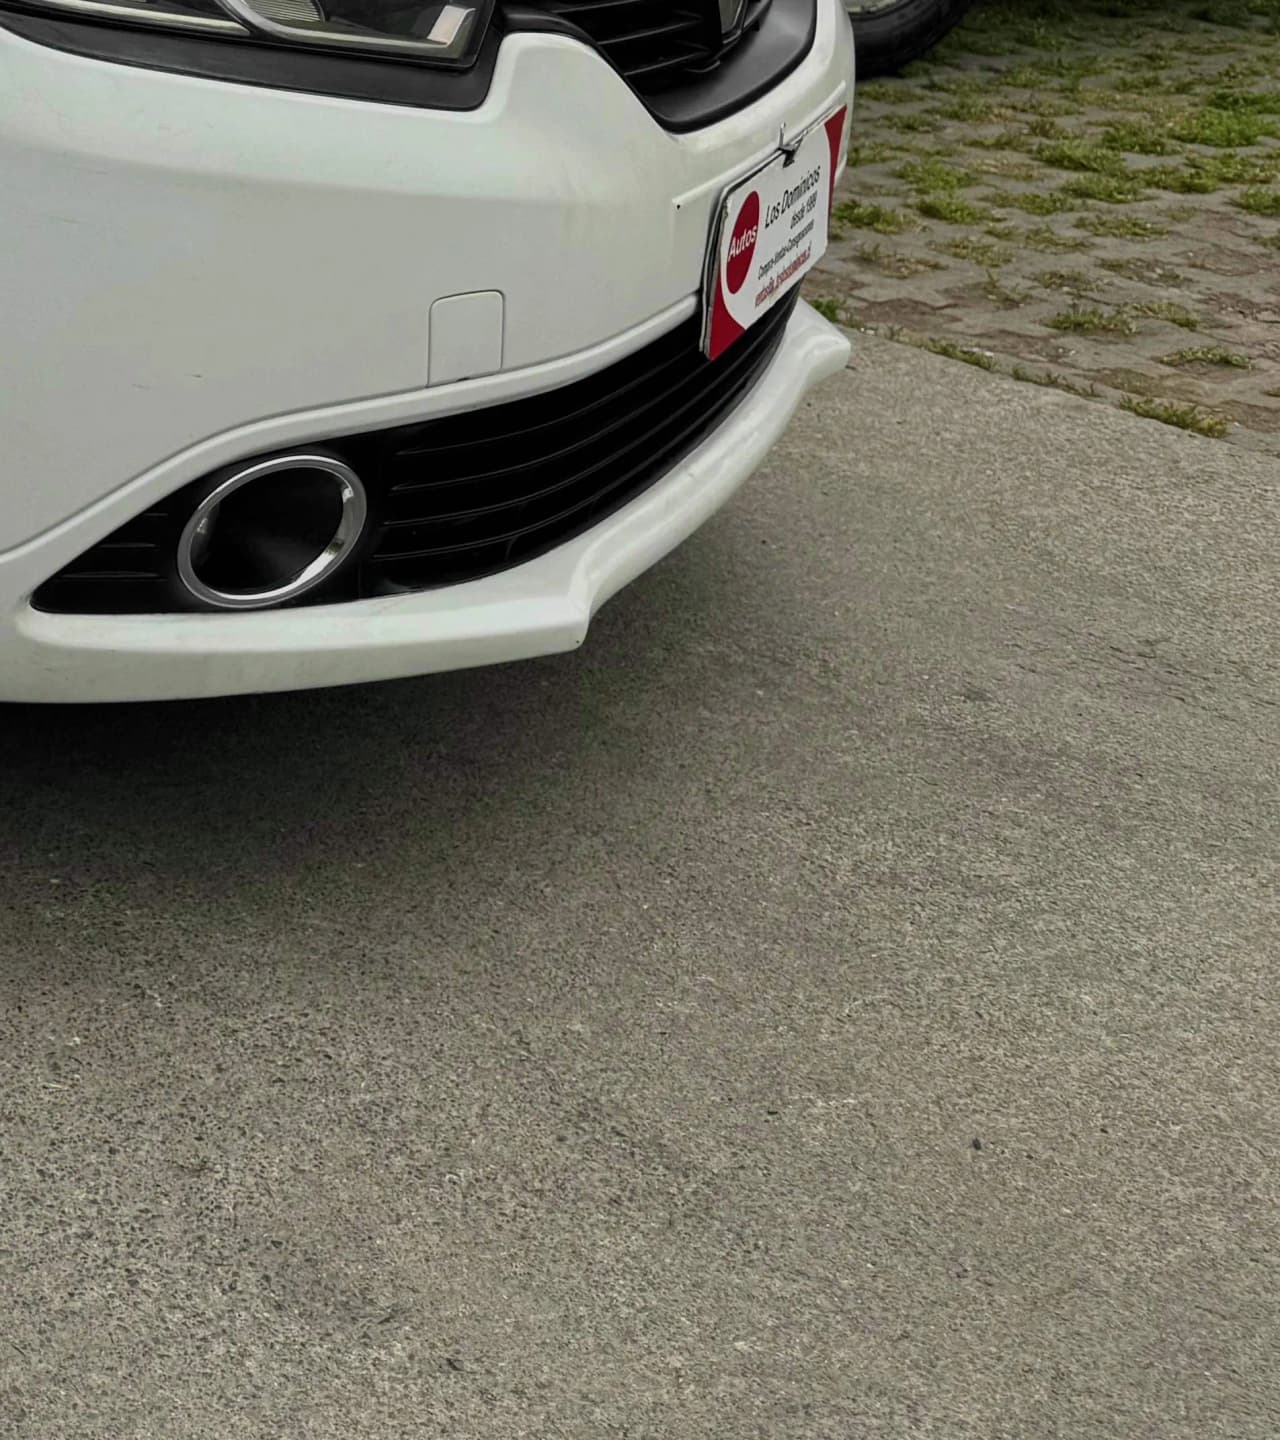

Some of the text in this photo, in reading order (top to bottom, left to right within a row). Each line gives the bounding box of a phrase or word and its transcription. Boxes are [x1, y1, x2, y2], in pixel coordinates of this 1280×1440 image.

[764, 164, 822, 230] Los Dominicos
[727, 224, 758, 262] Autos
